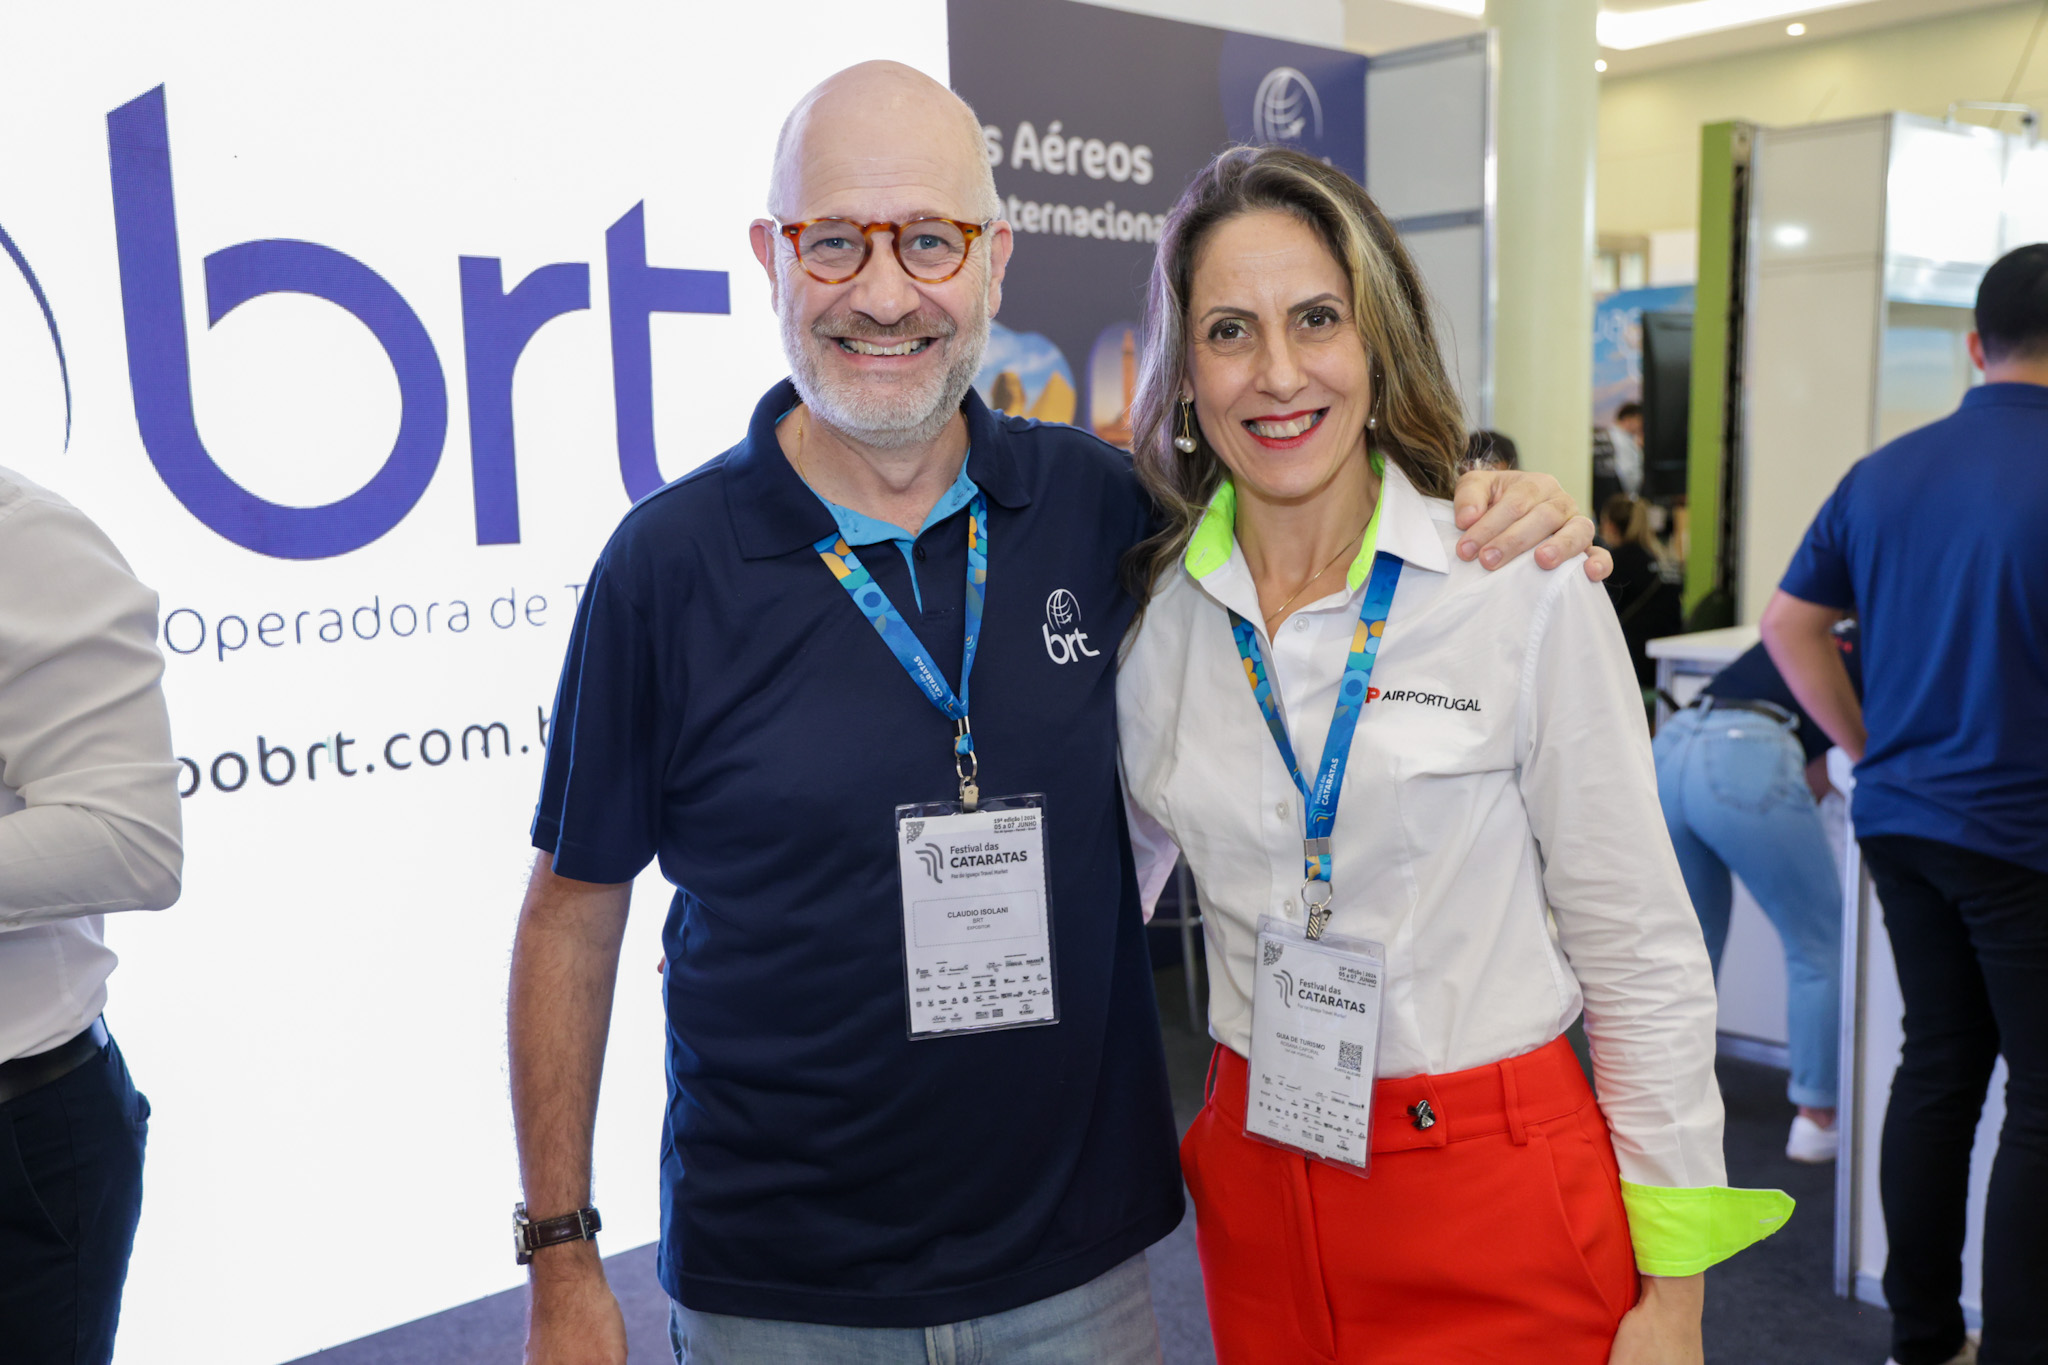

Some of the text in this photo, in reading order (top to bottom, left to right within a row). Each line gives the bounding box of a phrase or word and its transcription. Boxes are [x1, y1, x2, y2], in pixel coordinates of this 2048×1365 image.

[1011, 119, 1154, 186] Aéreos
[106, 82, 731, 561] brt
[164, 595, 470, 662] Operadora
[490, 587, 547, 629] de
[1042, 623, 1100, 665] brt
[913, 655, 943, 698] CATARATAS
[1321, 758, 1339, 806] CATARATAS
[950, 843, 999, 855] Festival das
[950, 850, 1028, 869] CATARATAS
[947, 907, 1009, 919] CLAUDIO ISOLANI
[1298, 989, 1366, 1014] CATARATAS
[1299, 978, 1327, 992] Festival
[1328, 984, 1341, 995] das
[1276, 1031, 1326, 1051] GUIA DE TURISMO
